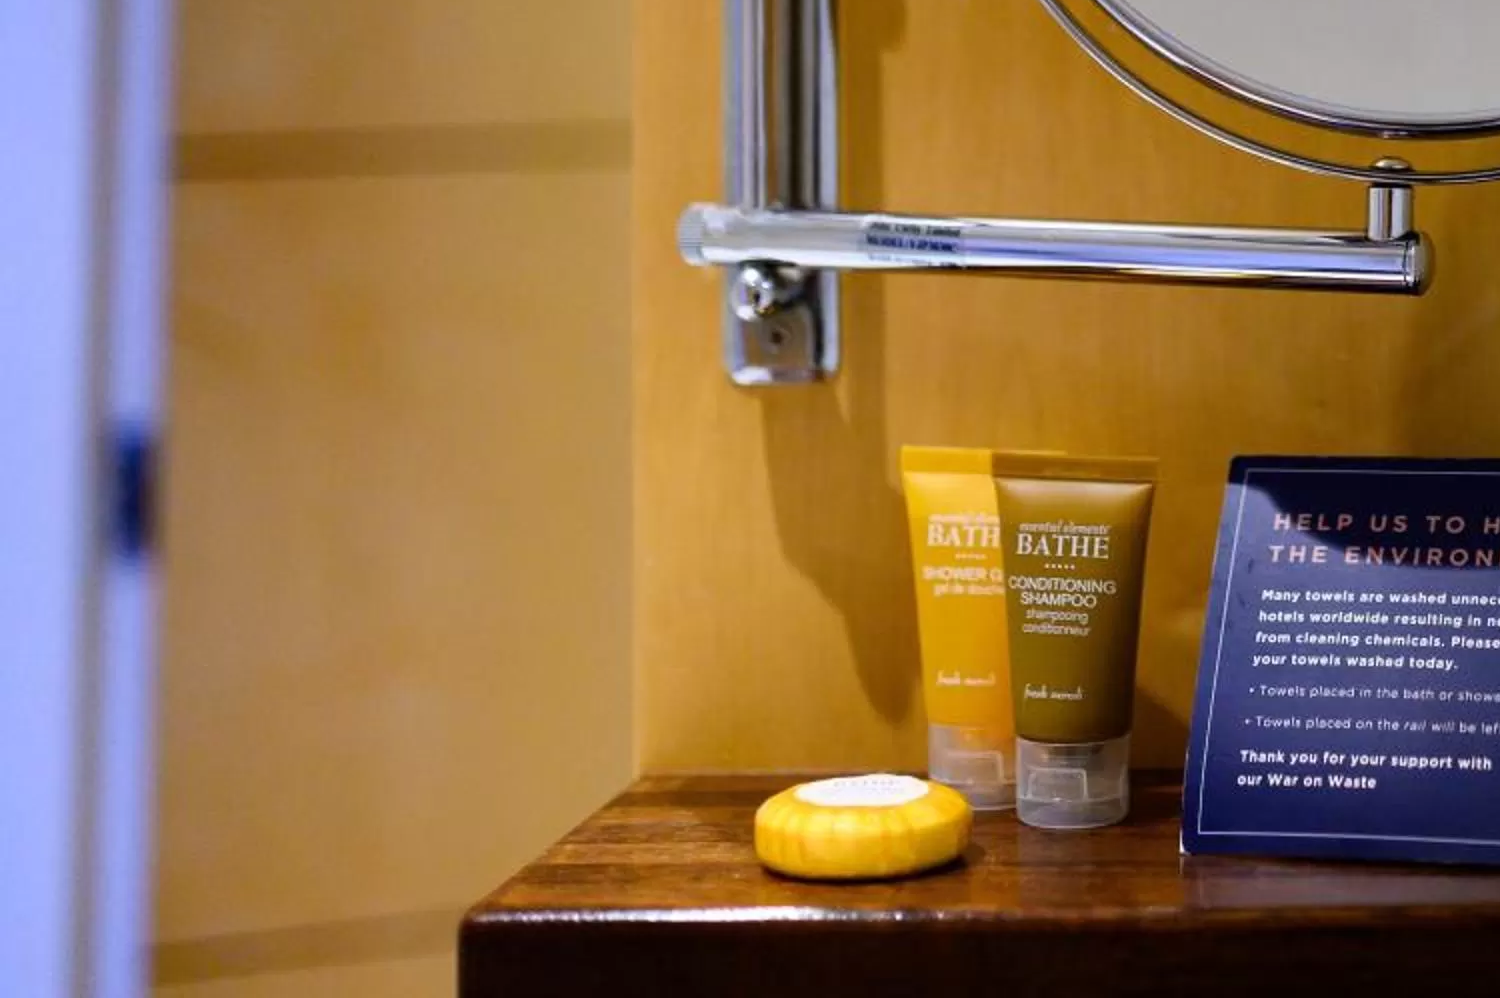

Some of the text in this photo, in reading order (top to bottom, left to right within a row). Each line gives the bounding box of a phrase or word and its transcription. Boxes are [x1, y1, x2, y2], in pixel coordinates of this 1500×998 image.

[1273, 513, 1353, 531] HELP
[1370, 514, 1408, 533] US
[1426, 515, 1465, 535] TO
[927, 523, 1001, 548] BATH
[1015, 533, 1110, 559] BATHE
[1268, 545, 1329, 563] THE
[1008, 575, 1116, 595] CONDITIONING
[1020, 592, 1097, 609] SHAMPOO
[1261, 589, 1300, 603] Many
[1305, 590, 1354, 603] towels
[1359, 593, 1384, 603] are
[1389, 592, 1447, 604] washed
[1258, 610, 1304, 623] hotels
[1309, 612, 1389, 624] worldwide
[1394, 613, 1462, 628] resulting
[1468, 614, 1481, 627] in
[1255, 631, 1291, 644] from
[1295, 632, 1360, 647] cleaning
[1365, 634, 1445, 647] chemicals.
[1451, 636, 1500, 649] Please
[1252, 654, 1458, 671] your towels washed today.
[1259, 684, 1305, 698] Towels
[1309, 685, 1355, 700] placed
[1359, 687, 1372, 699] in
[1376, 688, 1399, 699] the
[1403, 689, 1435, 701] bath
[1439, 692, 1454, 701] or
[1255, 715, 1301, 729] Towels
[1305, 716, 1351, 731] placed
[1355, 720, 1373, 730] on
[1377, 719, 1399, 730] the
[1404, 719, 1427, 731] rail
[1431, 720, 1455, 732] will
[1459, 722, 1477, 734] be
[1240, 749, 1493, 771] Thank you for your support with
[1237, 773, 1377, 789] our War on Waste
